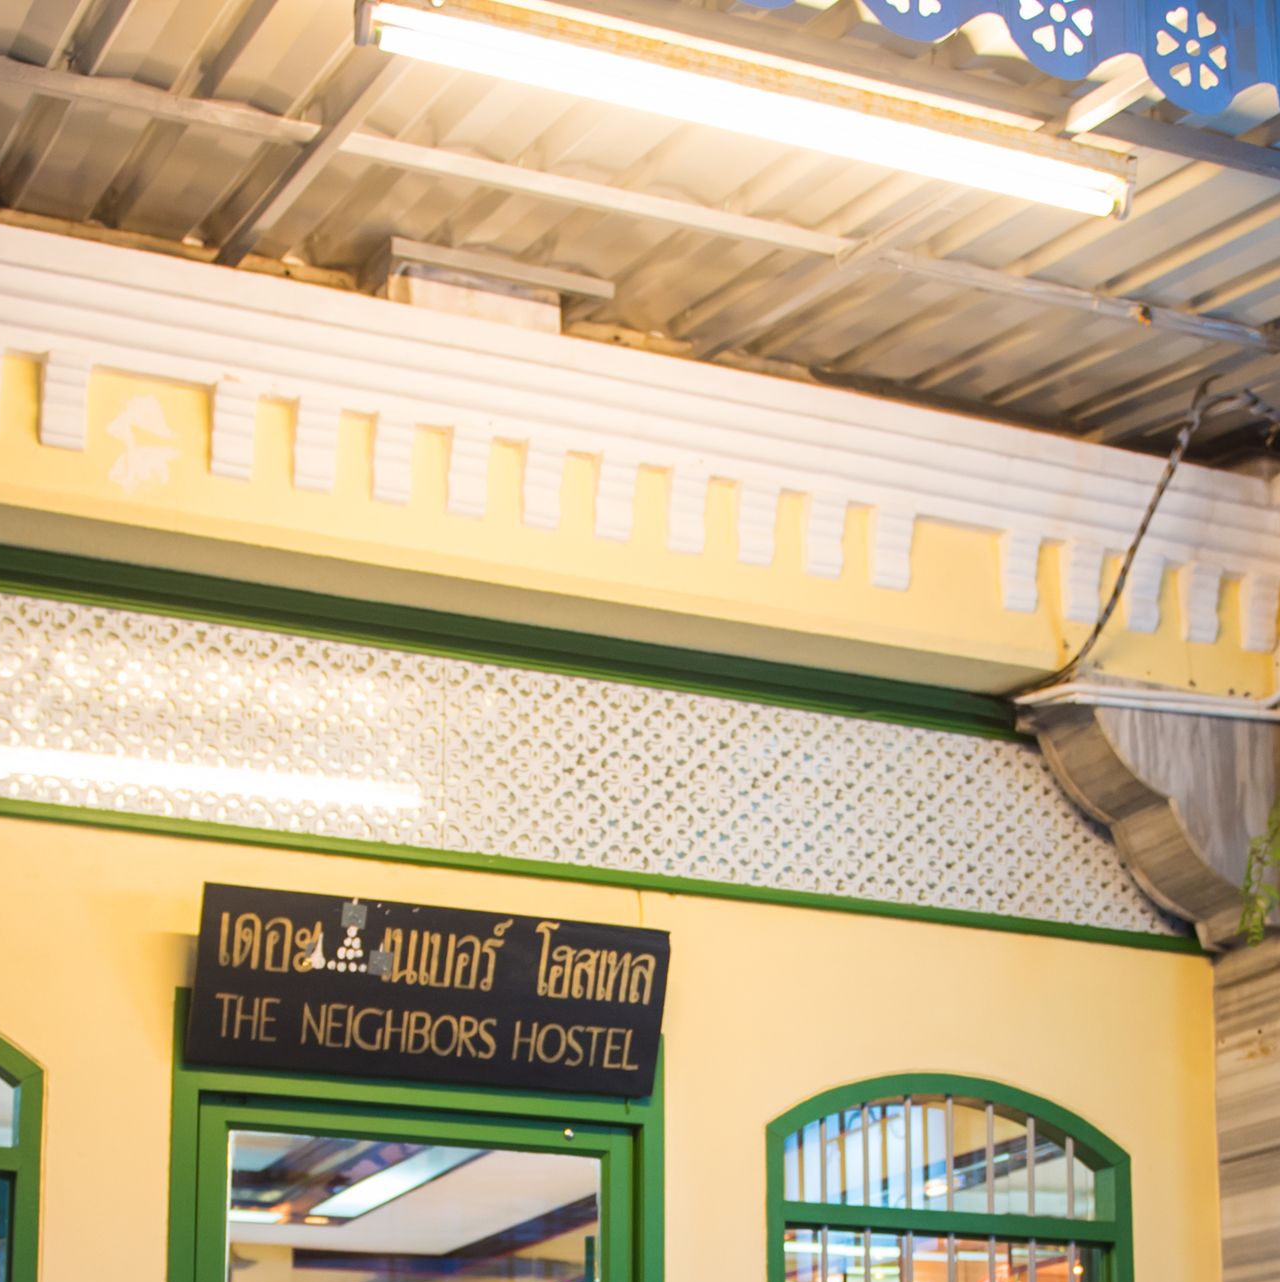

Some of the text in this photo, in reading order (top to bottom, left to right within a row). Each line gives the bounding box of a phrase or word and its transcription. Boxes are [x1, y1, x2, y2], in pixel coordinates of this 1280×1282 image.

[216, 993, 639, 1071] THE NEIGHBORS HOSTEL
